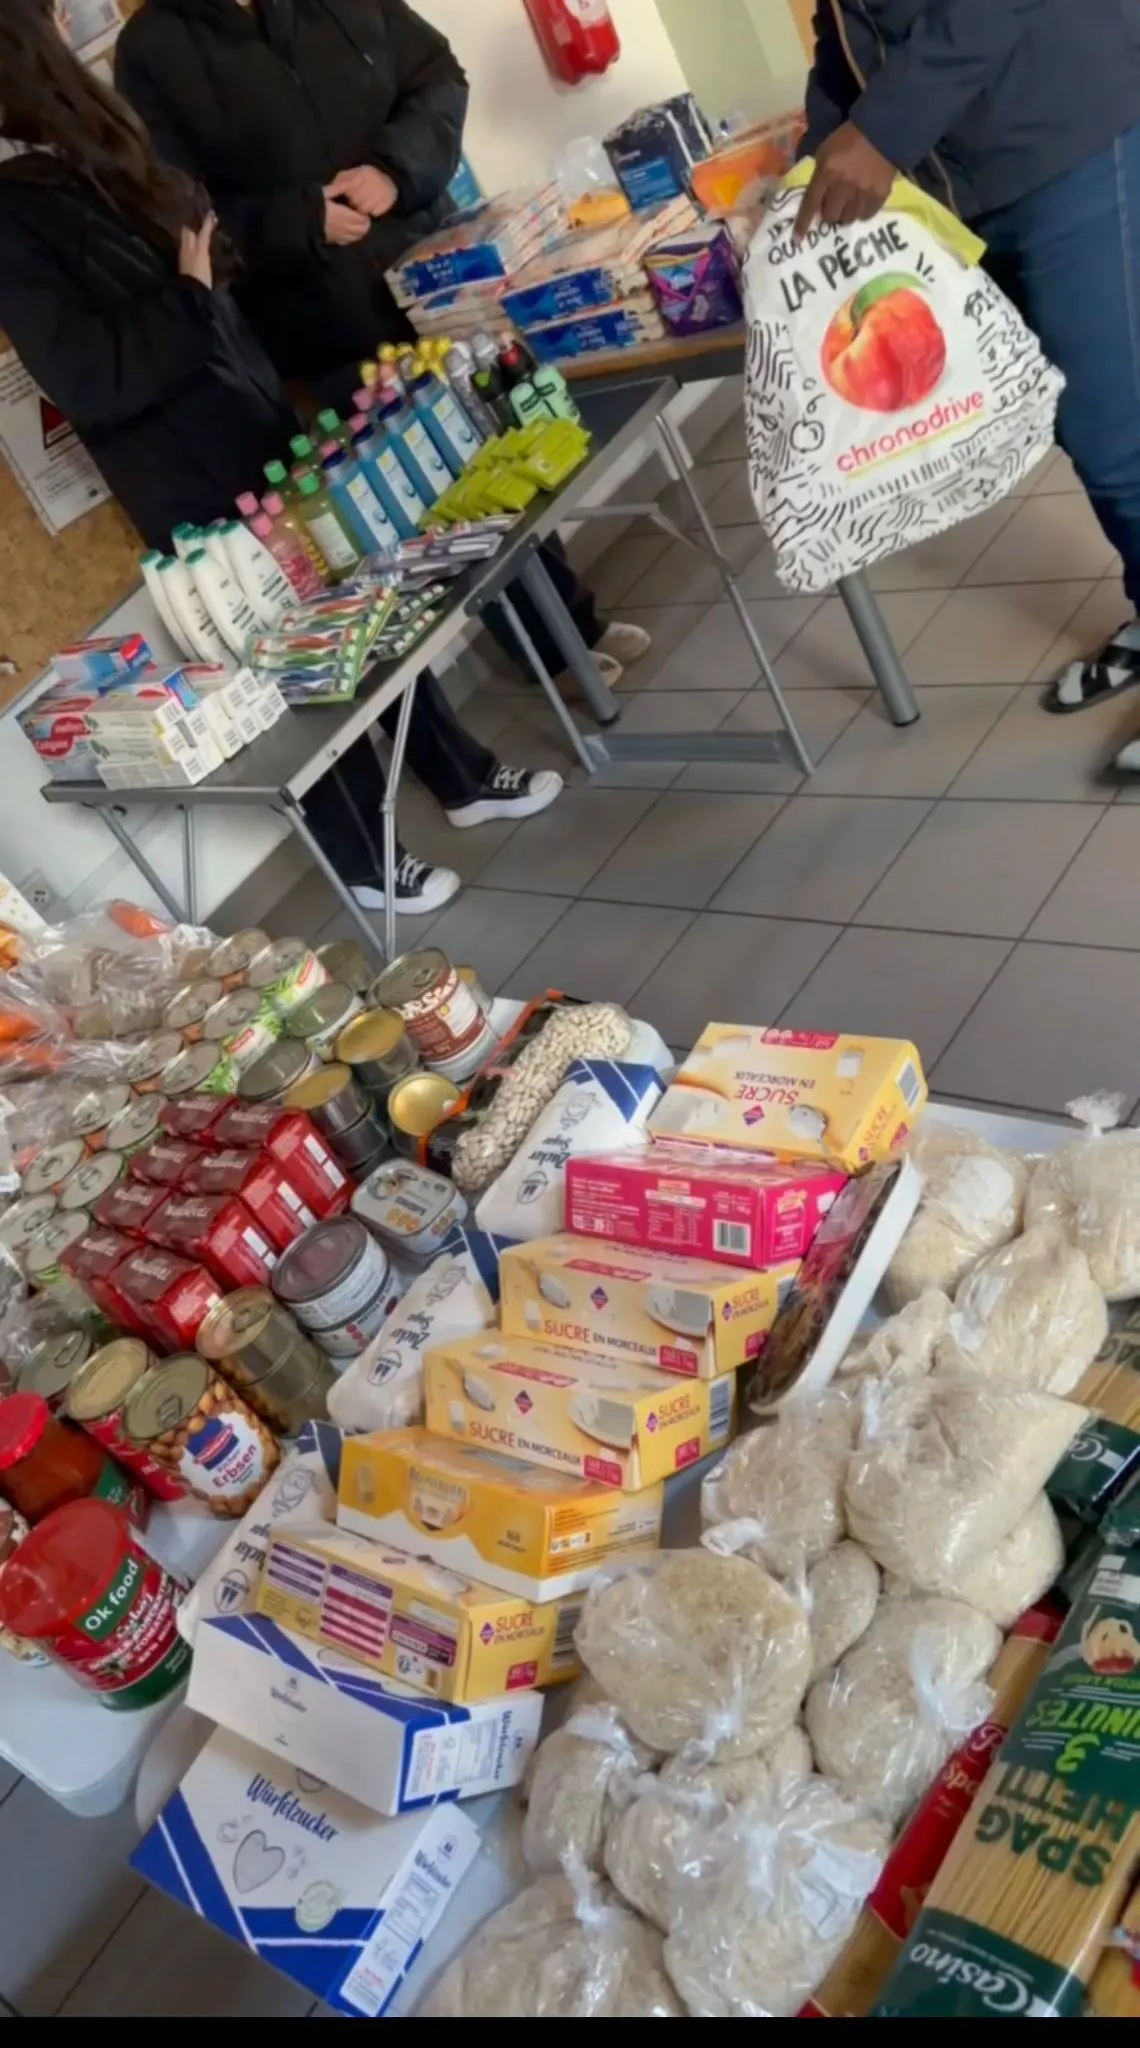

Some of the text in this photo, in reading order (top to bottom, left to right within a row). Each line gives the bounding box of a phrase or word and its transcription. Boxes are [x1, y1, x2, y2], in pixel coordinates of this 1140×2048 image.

[780, 270, 817, 312] LA
[818, 220, 909, 291] PÊCHE
[836, 389, 984, 473] chronodrive
[733, 1084, 799, 1106] SUCRE
[801, 1078, 816, 1090] EN
[732, 1286, 761, 1310] SUCRE
[544, 1320, 591, 1344] SUCRE
[593, 1334, 606, 1346] EN
[606, 1336, 657, 1358] MORCEAUX
[658, 1394, 691, 1420] SUCRE
[468, 1421, 581, 1466] SUCRE EN MORCEAUX
[212, 1444, 257, 1488] Erbsen
[84, 1606, 113, 1631] Ok
[108, 1557, 139, 1606] food
[495, 1610, 534, 1635] SUCRE
[1056, 1732, 1100, 1773] 3
[245, 1772, 340, 1843] Würfelzucker
[974, 1803, 1112, 1887] SPAG
[908, 1941, 1028, 2013] Casino
